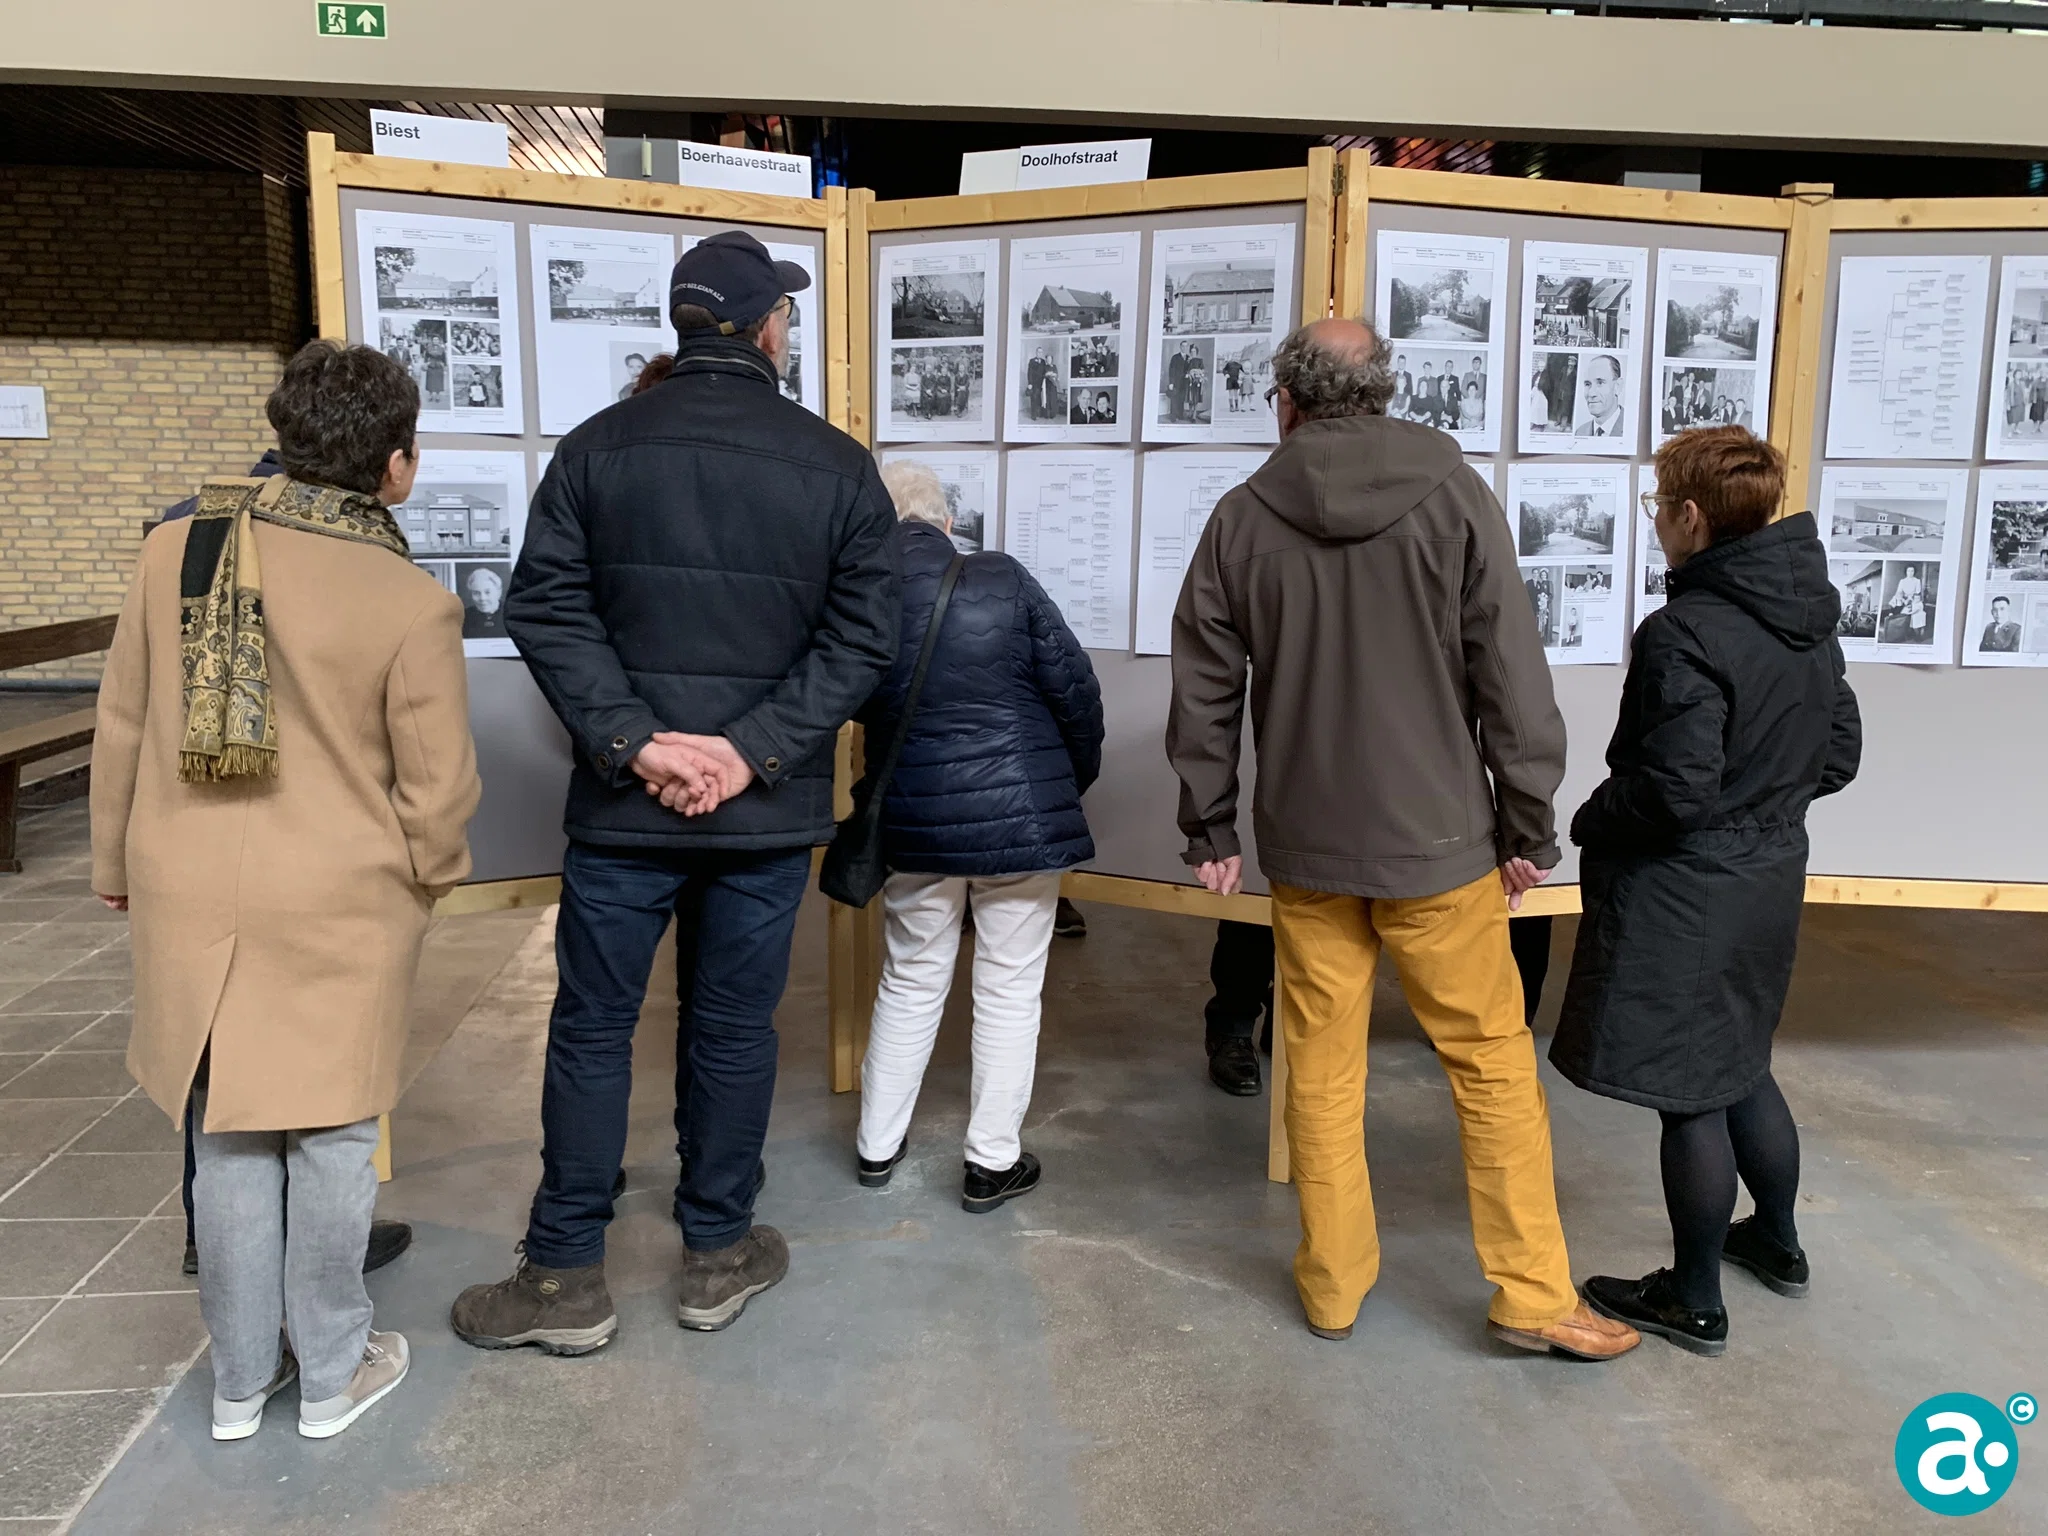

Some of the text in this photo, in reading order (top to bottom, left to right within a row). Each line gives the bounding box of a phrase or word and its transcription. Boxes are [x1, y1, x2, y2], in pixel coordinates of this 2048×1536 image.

[375, 121, 421, 139] Biest
[681, 147, 802, 174] Boerhaavestraat
[1021, 150, 1118, 167] Doolhofstraat
